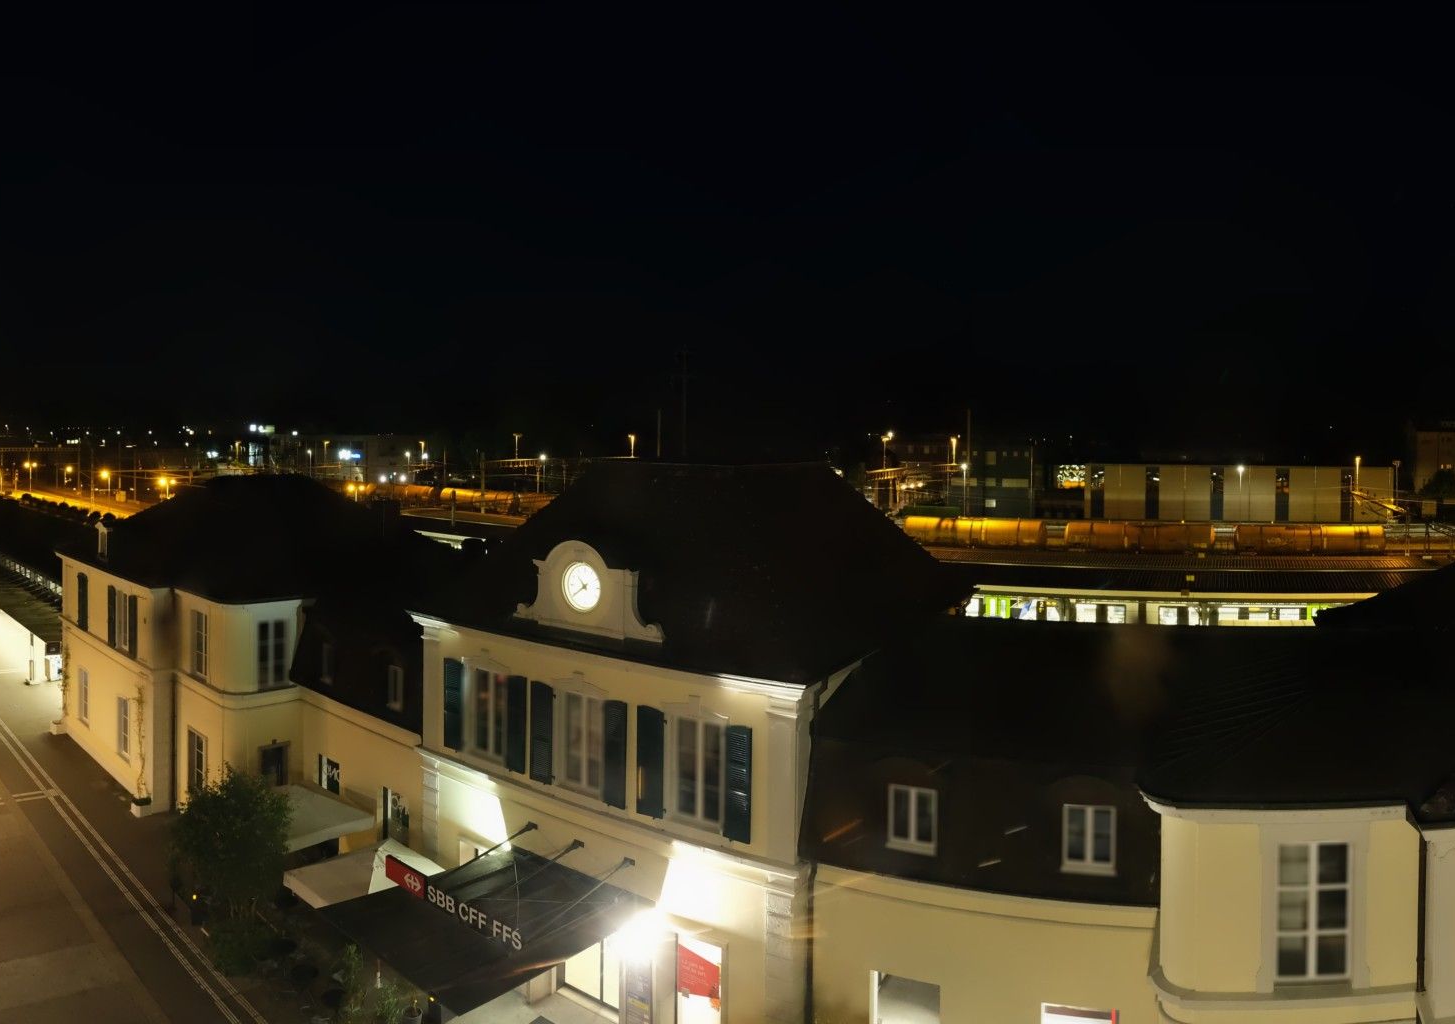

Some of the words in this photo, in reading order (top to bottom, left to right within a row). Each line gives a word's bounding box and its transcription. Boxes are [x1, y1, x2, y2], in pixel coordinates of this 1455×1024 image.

[427, 885, 456, 914] SBB
[458, 903, 487, 929] CFF
[492, 919, 522, 950] FFS
